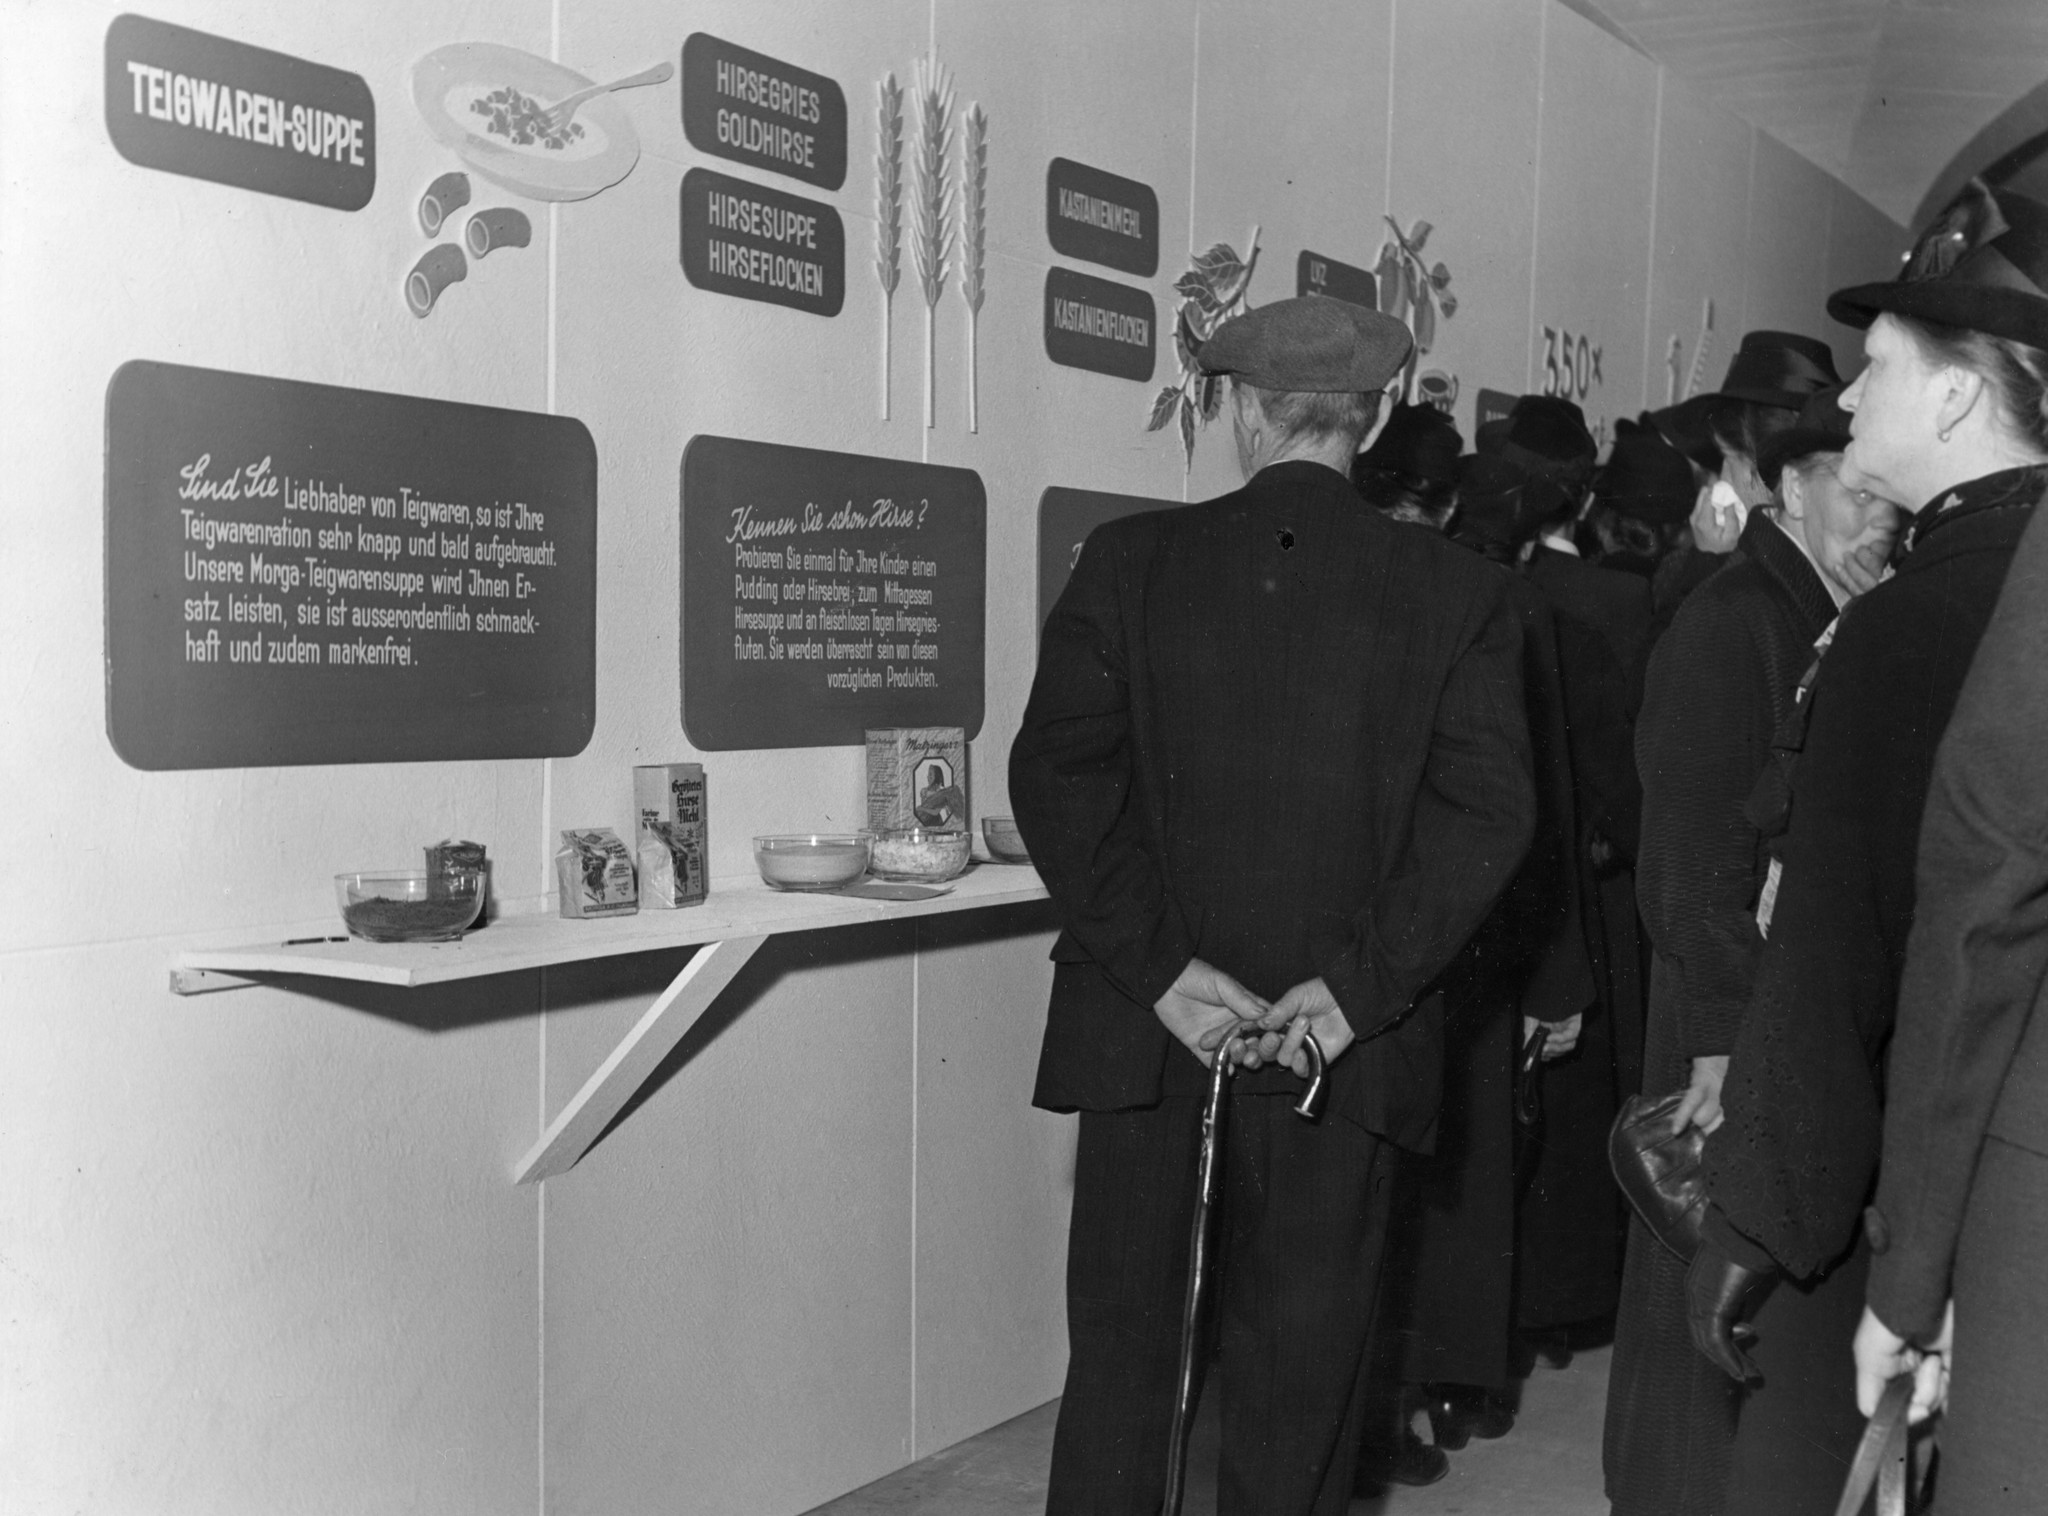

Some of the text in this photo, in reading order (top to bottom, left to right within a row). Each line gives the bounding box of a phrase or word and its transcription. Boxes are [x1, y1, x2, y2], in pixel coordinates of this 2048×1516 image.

[128, 61, 364, 166] TEIGWAREN-SUPPE
[716, 59, 820, 124] HIRSEGRIES
[716, 108, 815, 169] GOLDHIRSE
[708, 190, 817, 250] HIRSESUPPE
[1059, 187, 1142, 240] KASTANIENMEHL
[708, 238, 823, 297] HIRSEFLOCKEN
[1054, 297, 1148, 347] KASTANIENFLOCKEN
[179, 454, 240, 500] Sind
[244, 456, 279, 498] Sie
[285, 477, 366, 515] Liebhaber
[371, 497, 396, 518] von
[400, 488, 473, 530] Teigwaren,
[476, 507, 491, 526] so
[495, 501, 513, 528] ist
[181, 509, 556, 568] Teigwarenration sehr knapp und bald aufgebraucht.
[726, 505, 797, 543] Kennen
[801, 503, 823, 533] Sie
[827, 501, 868, 530] schon
[185, 551, 243, 582] Unsere
[251, 552, 424, 594] Morga-Teigwarensuppe
[431, 568, 462, 594] wird
[516, 573, 536, 598] Er-
[736, 543, 783, 569] Probieren
[787, 546, 801, 570] Sie
[804, 548, 836, 571] einmal
[839, 548, 854, 572] für
[880, 551, 909, 574] Kinder
[912, 555, 936, 576] einen
[185, 592, 539, 633] satz leisten, sie ist ausserordentlich schmack-
[736, 574, 778, 605] Pudding
[783, 578, 805, 600] oder
[858, 586, 877, 602] zum
[885, 581, 932, 607] Mittagessen
[735, 607, 940, 636] Hirsesuppe und an fleischlosen Tagen Hirsegries-
[186, 629, 418, 665] haft und zudem markenfrei.
[770, 636, 784, 660] Sie
[787, 637, 823, 659] werden
[827, 638, 873, 659] überrascht
[878, 641, 894, 660] sein
[896, 644, 909, 659] von
[912, 640, 938, 659] diesen
[827, 666, 938, 692] vorzüglichen Produkten.
